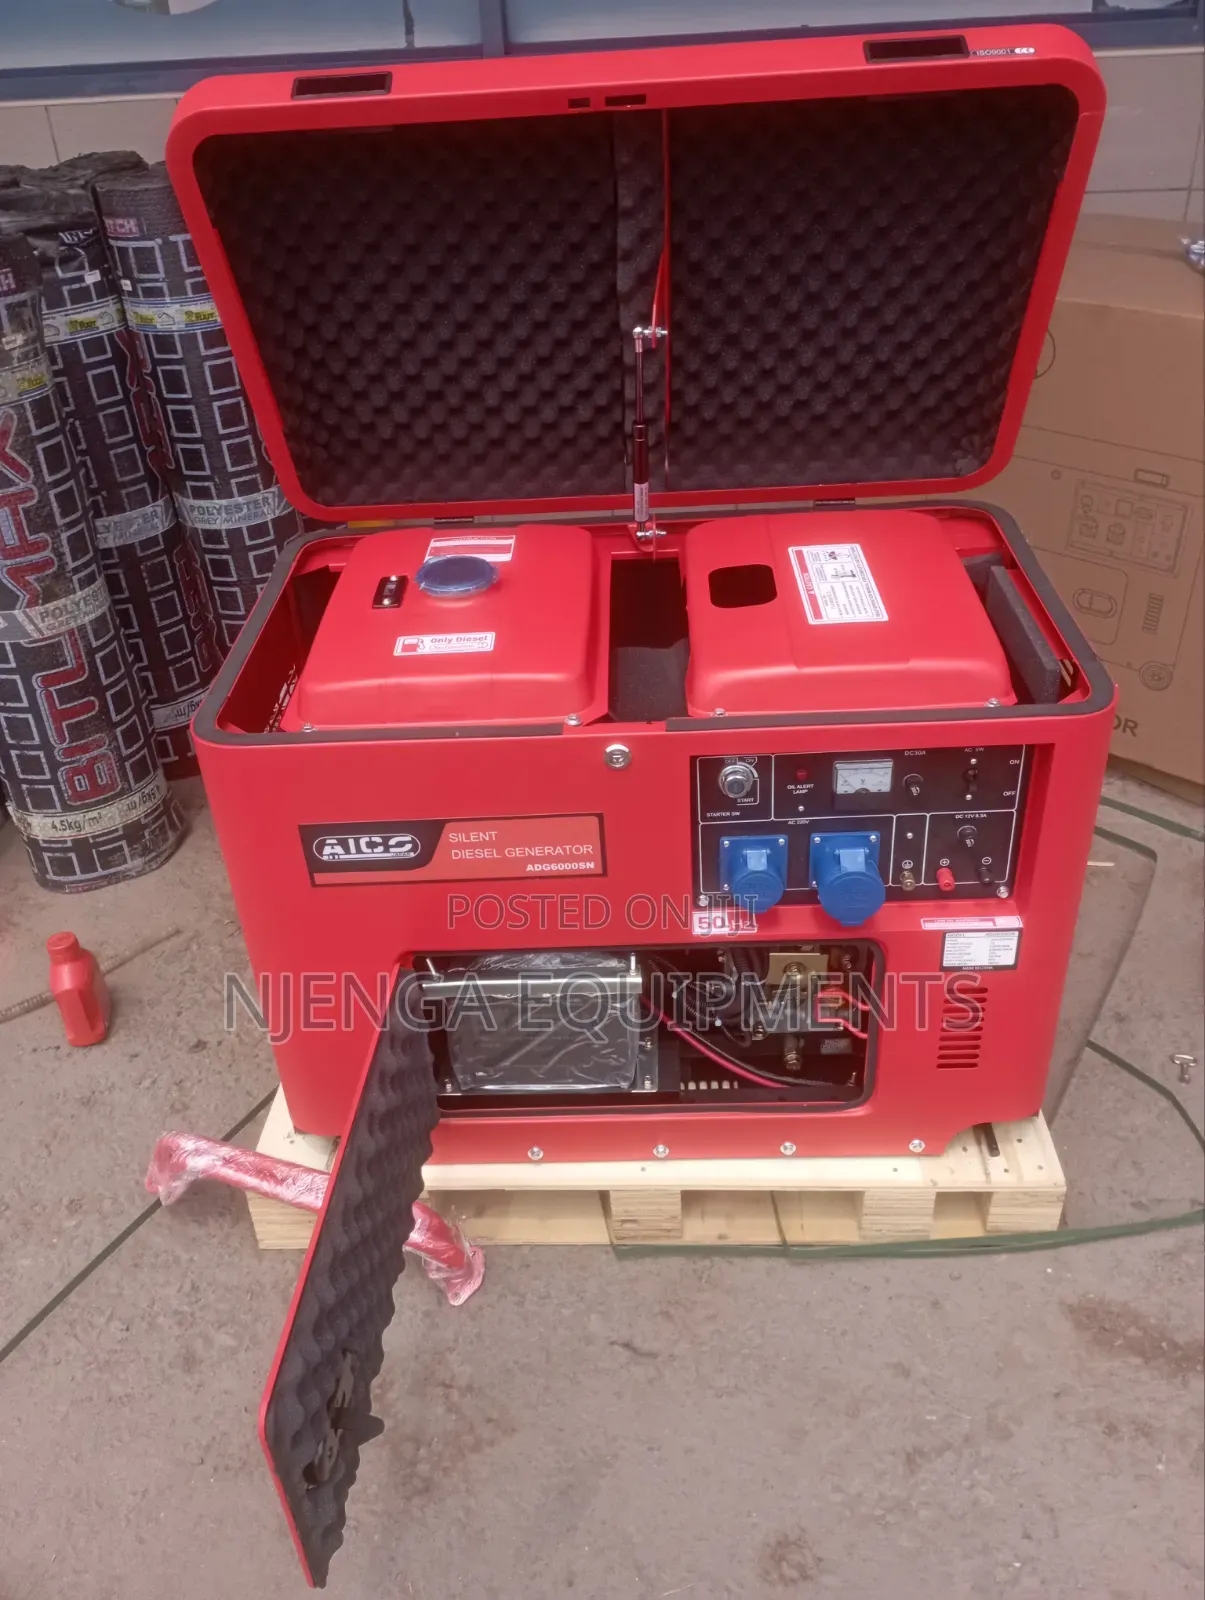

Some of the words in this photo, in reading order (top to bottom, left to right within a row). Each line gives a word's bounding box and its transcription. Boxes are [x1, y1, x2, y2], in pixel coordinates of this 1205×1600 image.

[189, 496, 272, 516] POLYESTER
[223, 510, 272, 525] MINERAL
[430, 637, 453, 645] Only
[456, 635, 488, 643] Diesel
[449, 832, 498, 843] SILENT
[451, 848, 501, 860] DIESEL
[504, 844, 593, 858] GENERATOR
[525, 862, 595, 872] ADG6000SN
[698, 916, 726, 930] 50
